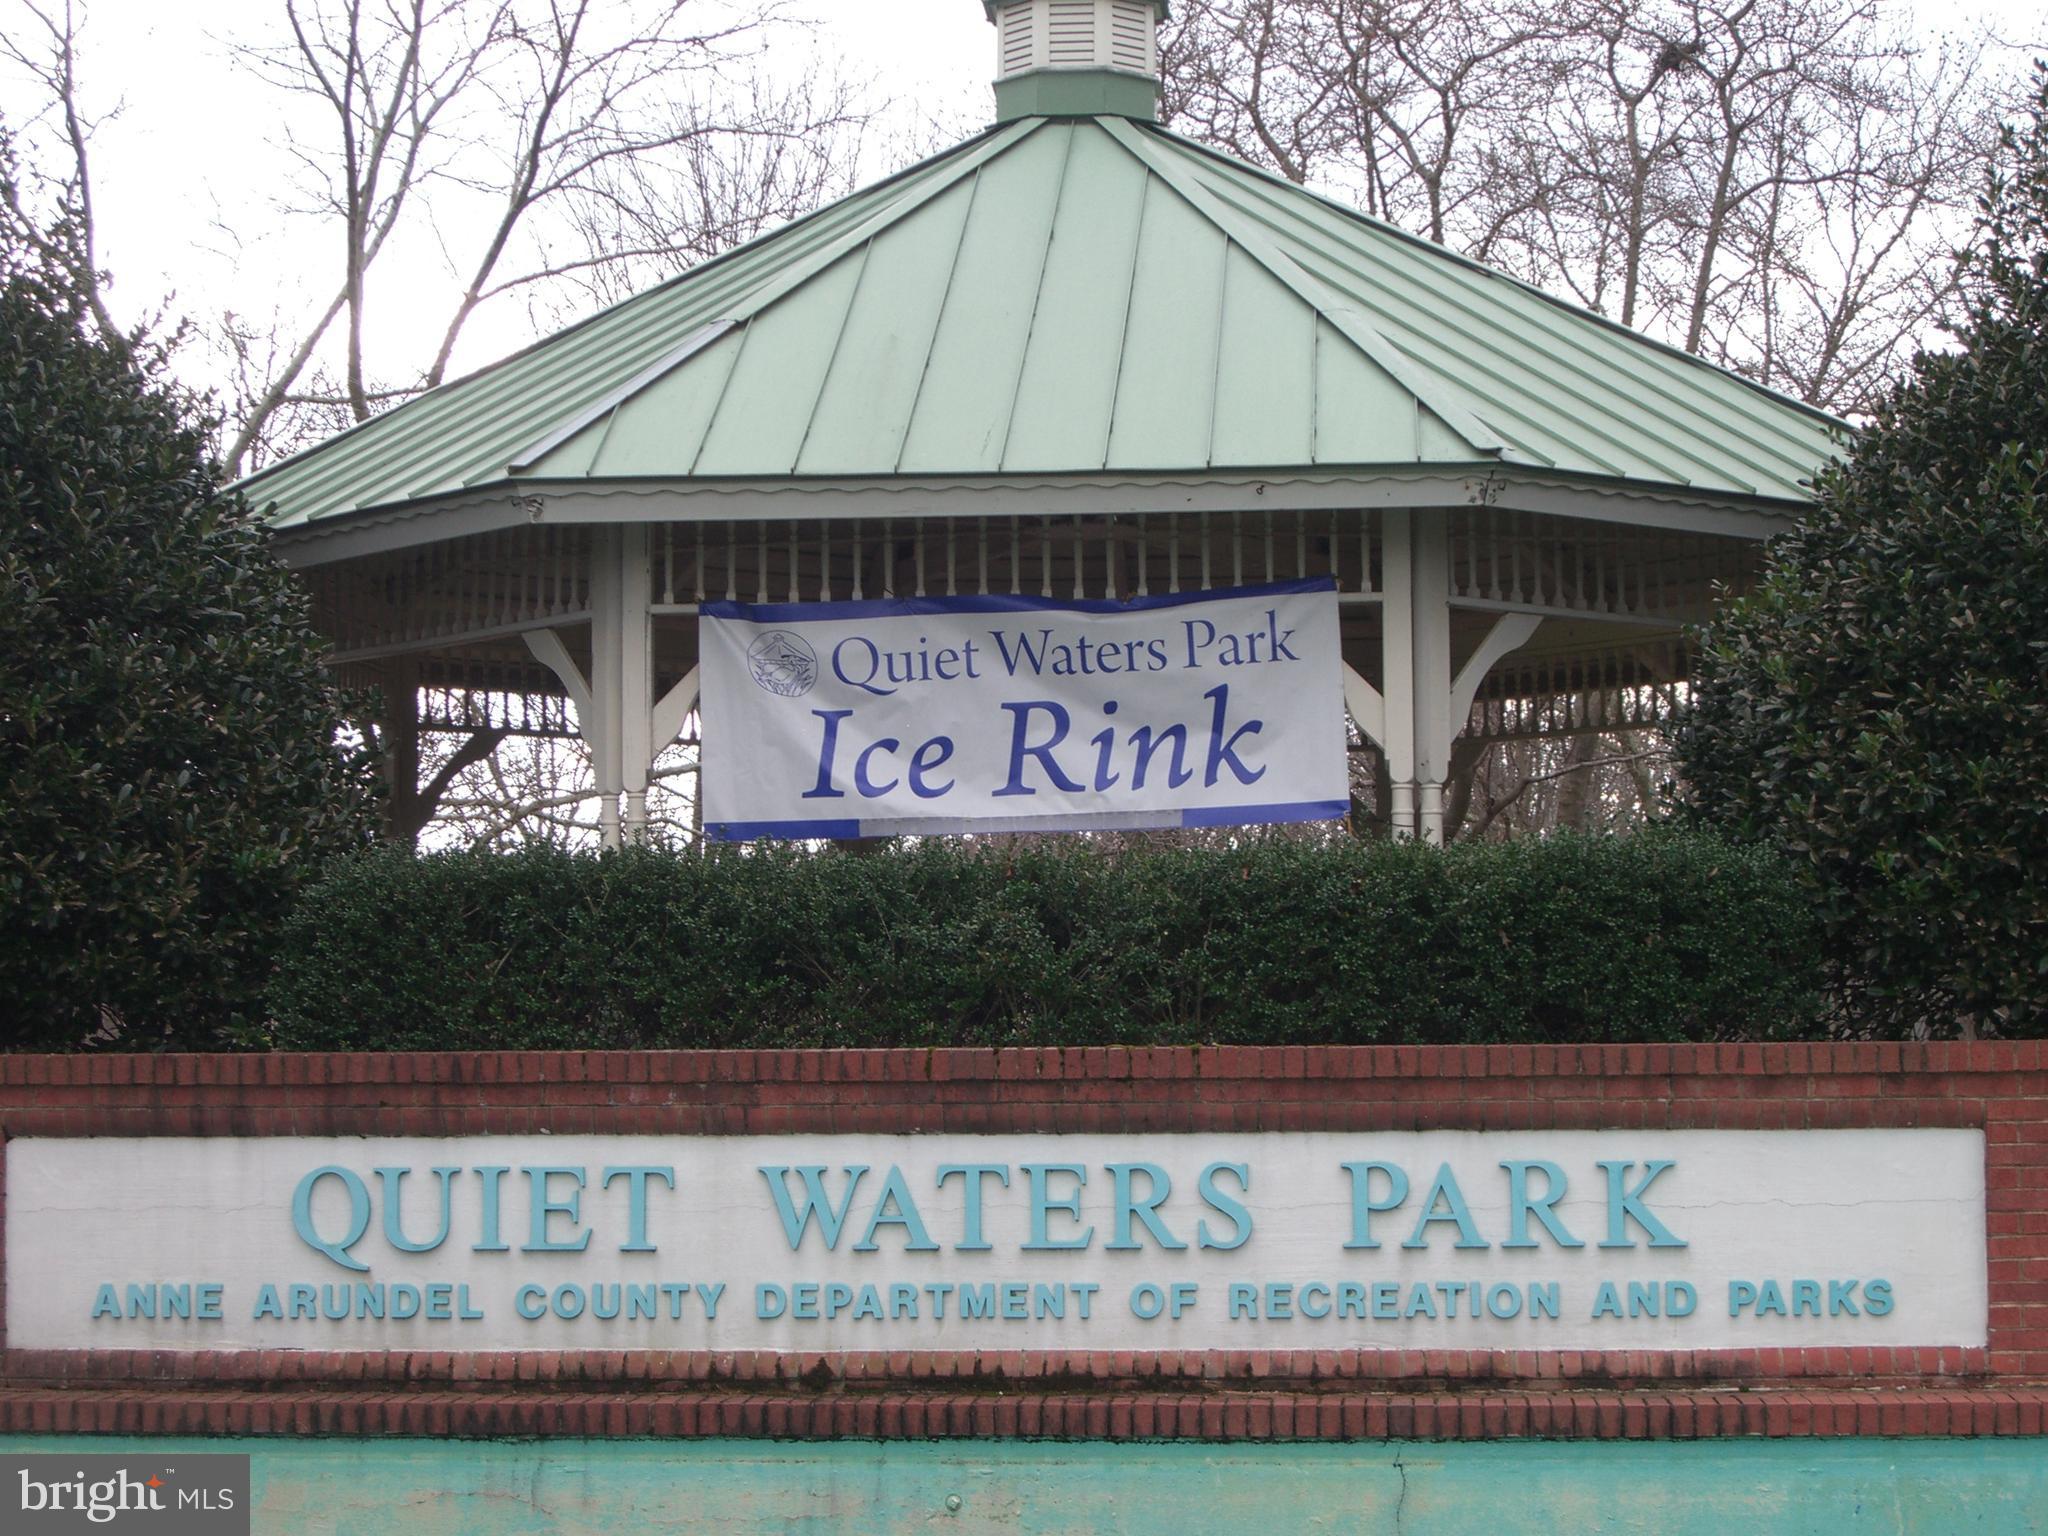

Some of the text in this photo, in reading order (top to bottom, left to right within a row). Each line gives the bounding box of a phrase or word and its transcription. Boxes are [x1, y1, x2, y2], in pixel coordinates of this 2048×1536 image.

[832, 610, 1300, 695] Quiet Waters Park
[801, 684, 1266, 799] Ice Rink
[292, 1160, 1688, 1271] QUIET WATERS PARK
[91, 1279, 1894, 1321] ANNE ARUNDEL COUNTY DEPARTMENT OF RECREATION AND PARKS
